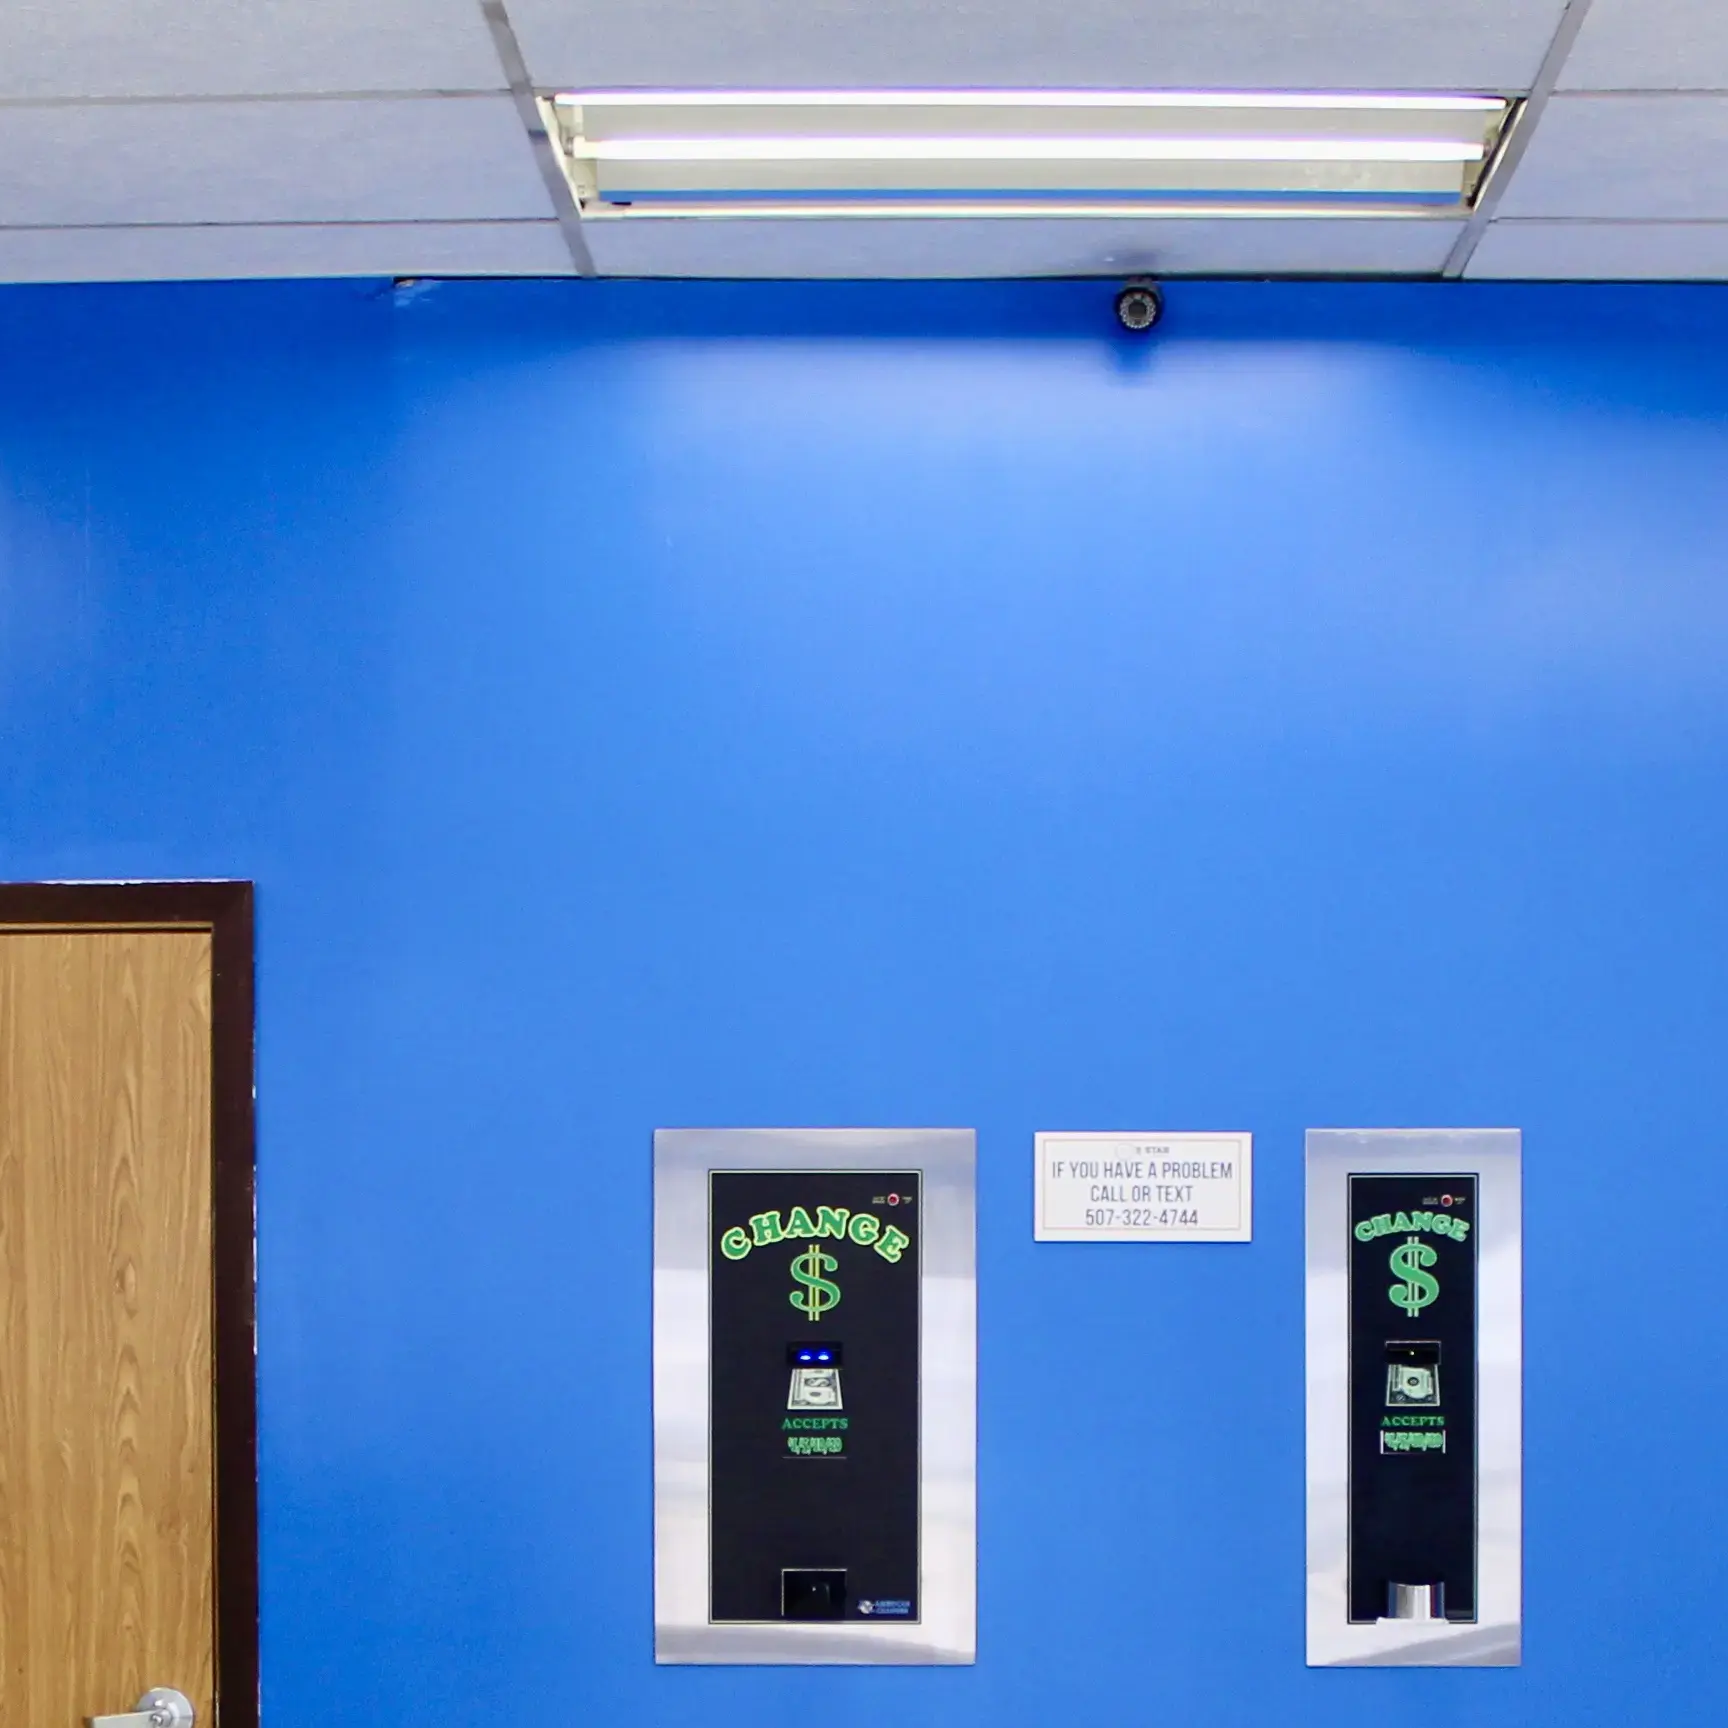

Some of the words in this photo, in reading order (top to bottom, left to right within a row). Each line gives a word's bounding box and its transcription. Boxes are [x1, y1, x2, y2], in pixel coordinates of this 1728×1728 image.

[1052, 1161, 1065, 1179] IF
[1069, 1161, 1098, 1179] YOU
[1104, 1161, 1143, 1179] HAVE
[1147, 1161, 1157, 1179] A
[1162, 1161, 1233, 1179] PROBLEM
[1090, 1185, 1127, 1203] CALL
[1132, 1185, 1151, 1203] OR
[1156, 1185, 1193, 1203] TEXT
[1085, 1208, 1198, 1226] 507-322-4744
[721, 1206, 909, 1263] CHANGE
[1355, 1211, 1470, 1242] CHANGE
[782, 1417, 848, 1429] ACCEPTS
[1382, 1415, 1444, 1426] ACCEPTS
